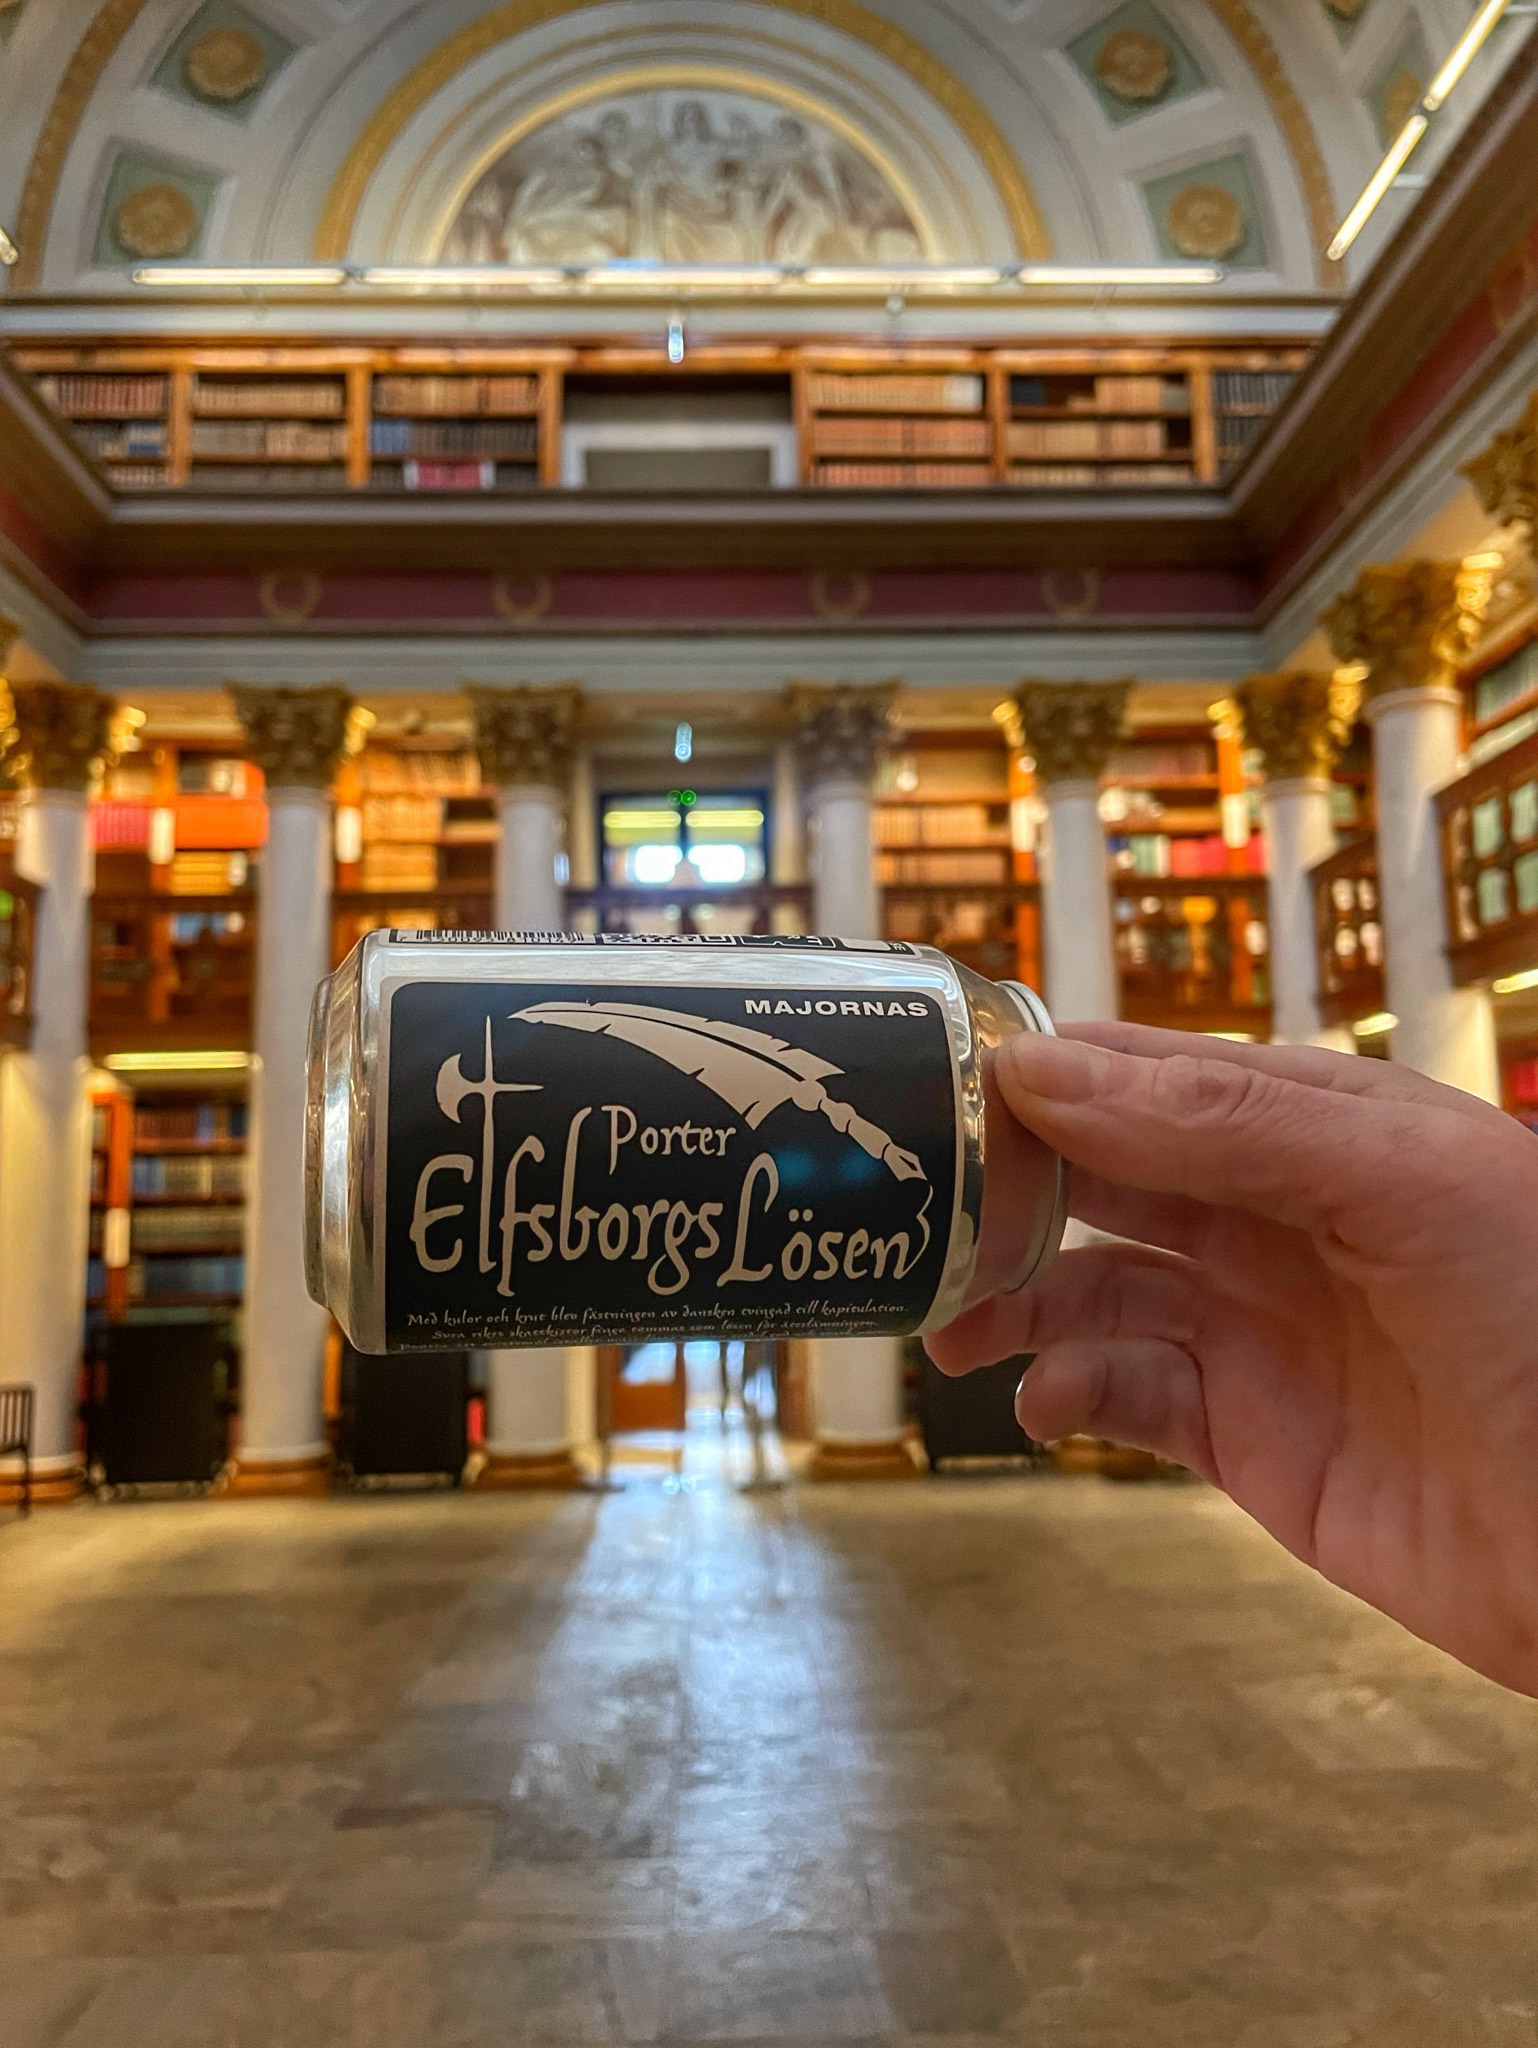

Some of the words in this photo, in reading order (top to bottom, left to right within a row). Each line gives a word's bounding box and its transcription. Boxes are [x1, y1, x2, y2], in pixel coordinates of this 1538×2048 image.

[744, 998, 930, 1018] MAJORNAS
[601, 1105, 737, 1176] Porter
[409, 1106, 724, 1297] Elfsborgs
[716, 1151, 934, 1287] Lösen
[407, 1311, 438, 1327] Med
[443, 1308, 482, 1327] kulor
[486, 1307, 509, 1324] och
[514, 1306, 547, 1325] krut
[582, 1306, 656, 1326] fästningen
[660, 1309, 678, 1319] av
[682, 1302, 735, 1320] dansken
[741, 1301, 791, 1319] tvingad
[796, 1299, 820, 1315] till
[690, 1324, 715, 1332] som
[756, 1318, 775, 1332] för
